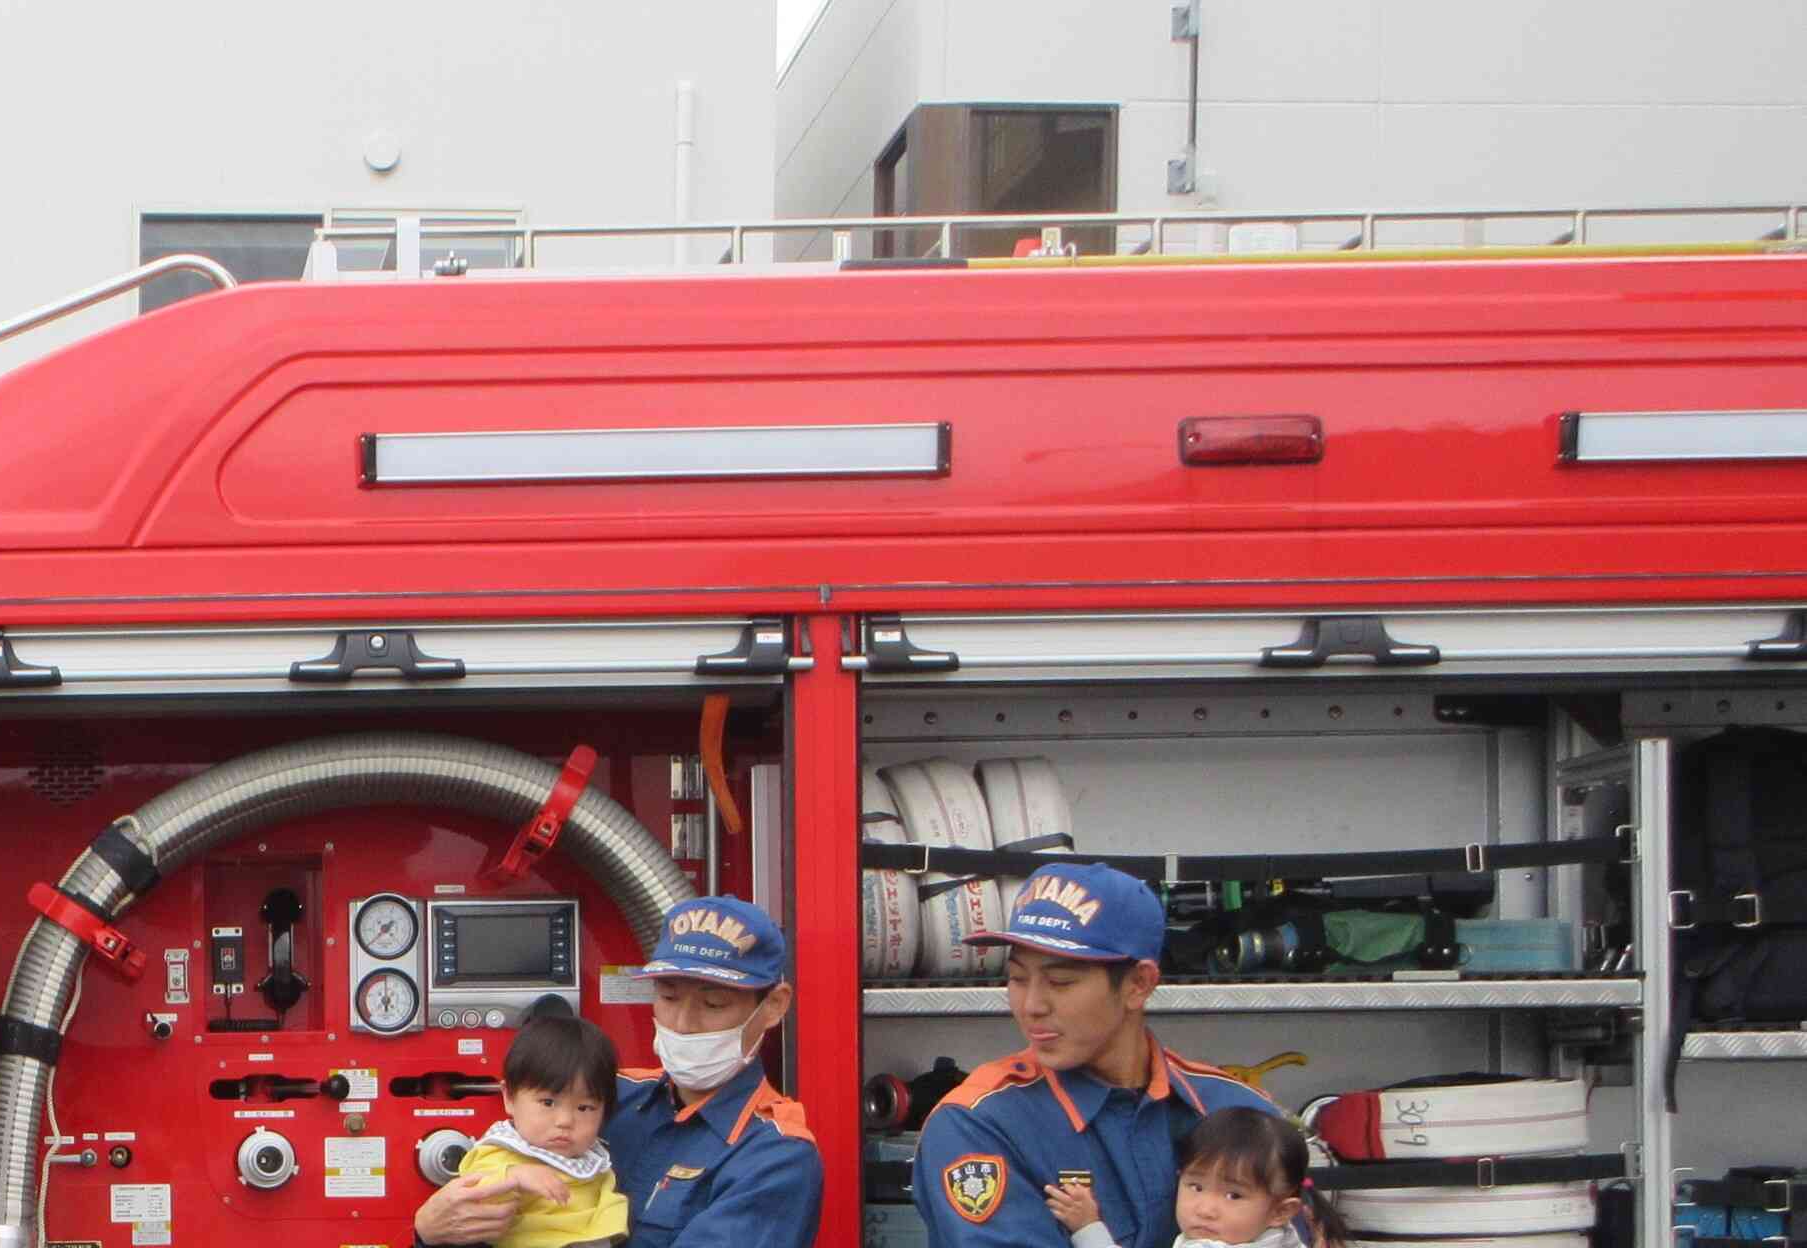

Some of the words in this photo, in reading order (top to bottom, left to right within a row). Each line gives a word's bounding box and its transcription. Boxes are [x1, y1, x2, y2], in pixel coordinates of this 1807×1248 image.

[1016, 874, 1100, 927] YAMA
[1037, 916, 1072, 932] DEPT.
[699, 946, 732, 961] DEPT.
